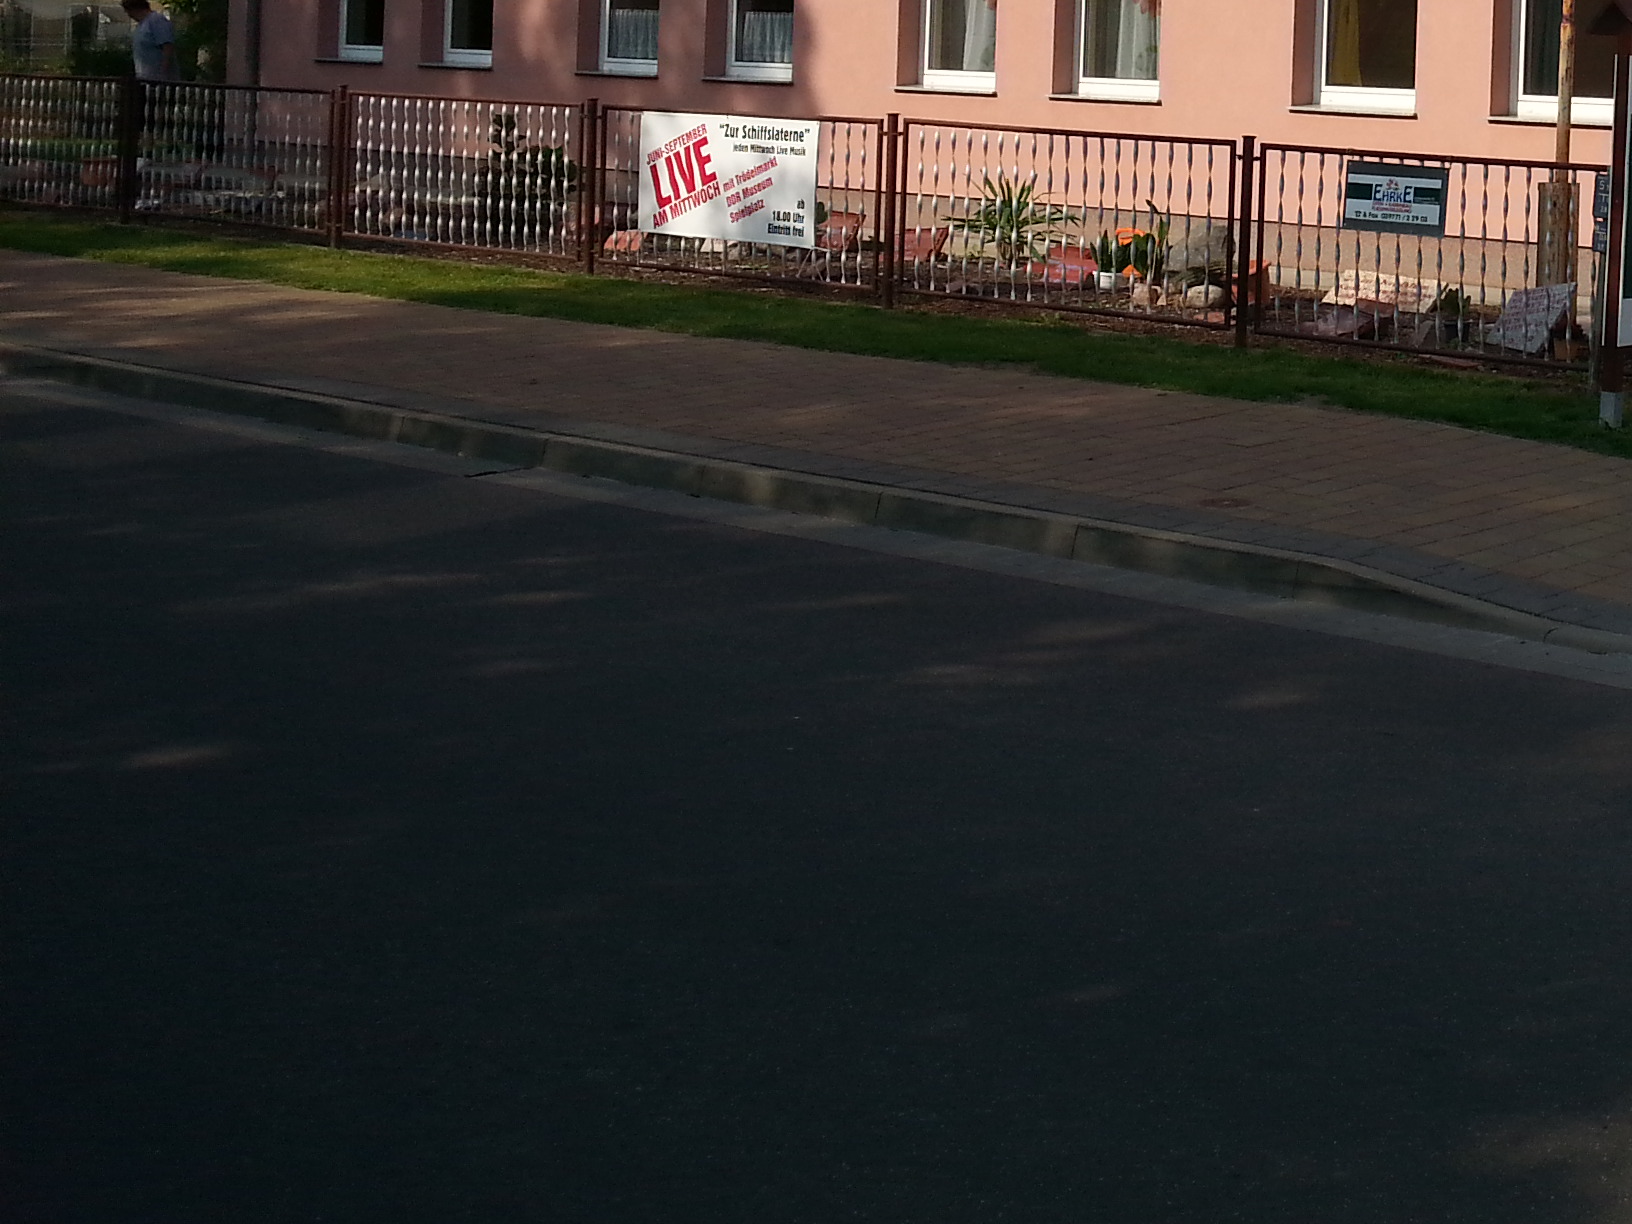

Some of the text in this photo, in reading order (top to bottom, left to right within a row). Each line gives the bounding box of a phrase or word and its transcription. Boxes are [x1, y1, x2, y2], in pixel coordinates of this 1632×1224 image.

[646, 123, 708, 165] JUNI-SEPTEMBER
[649, 136, 718, 209] LIVE
[652, 181, 721, 230] AM MITTWOCH
[792, 212, 805, 223] Uhr
